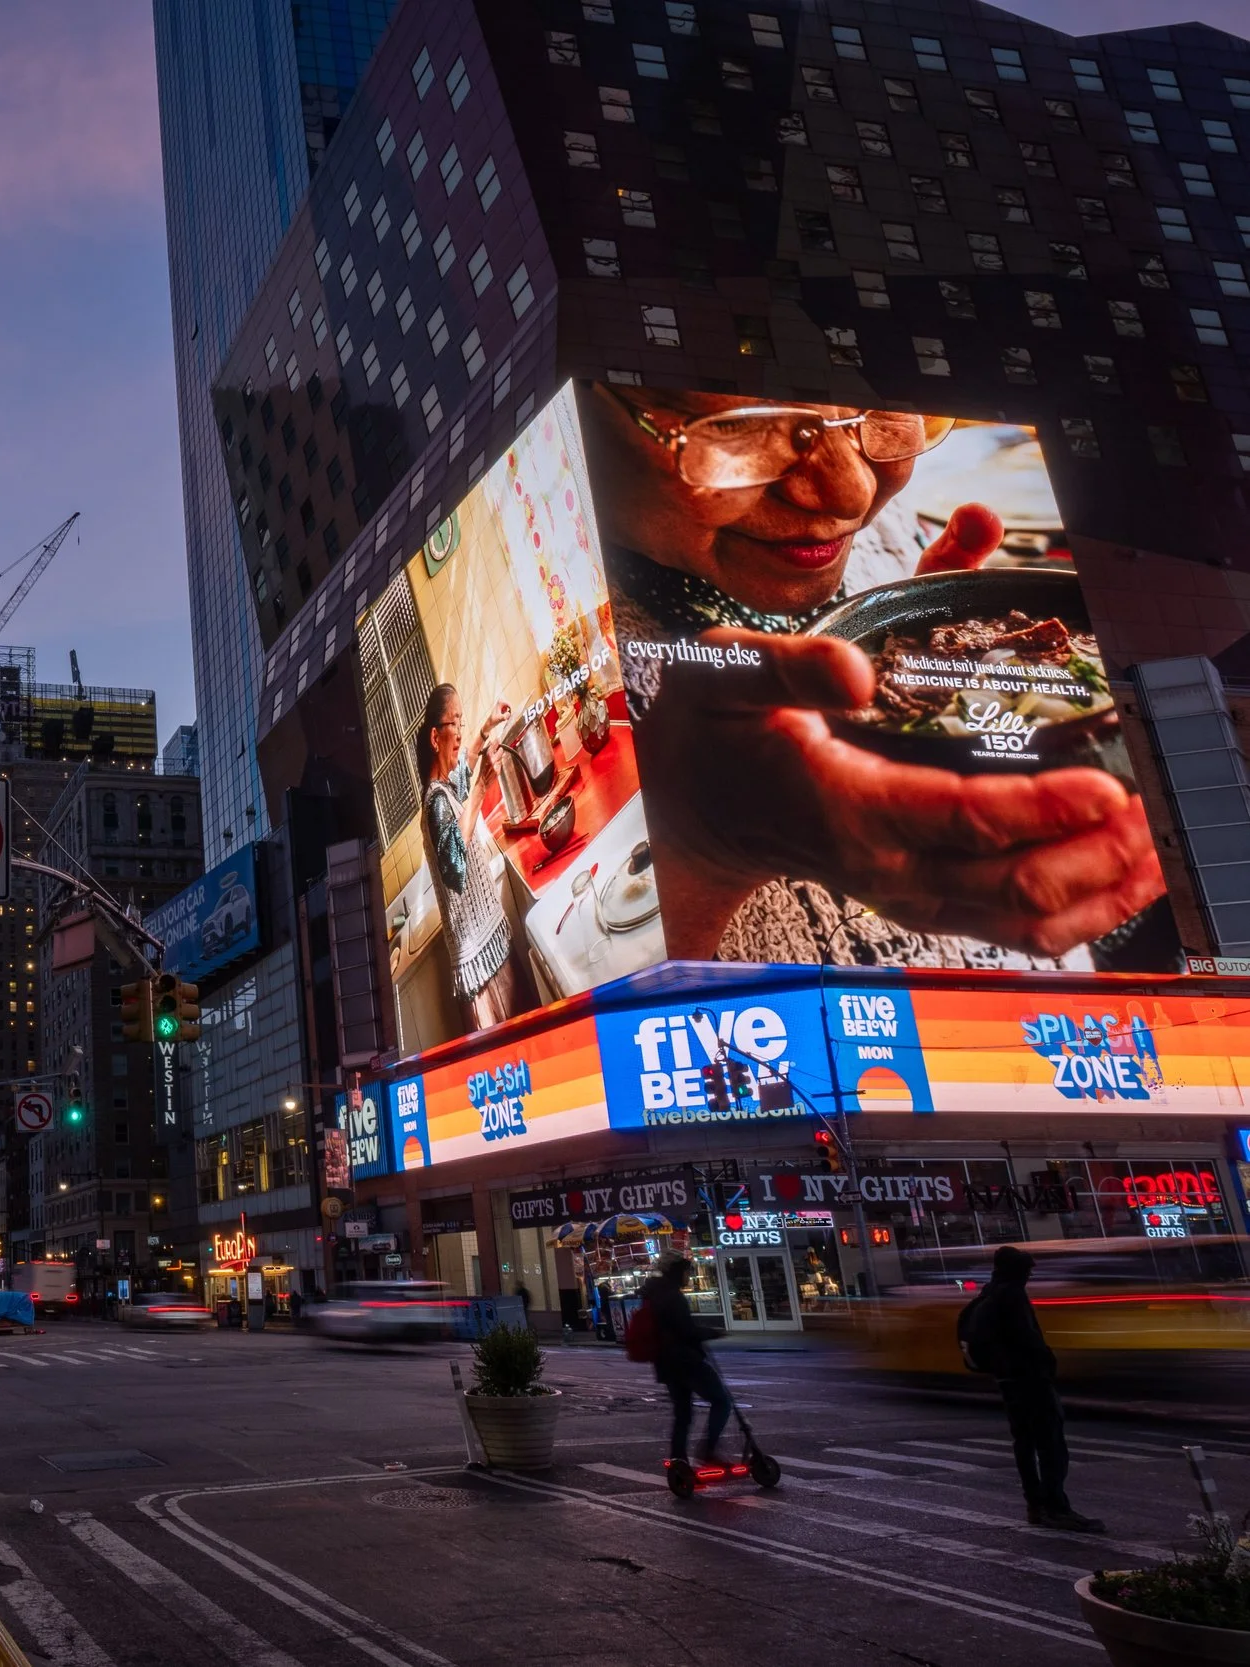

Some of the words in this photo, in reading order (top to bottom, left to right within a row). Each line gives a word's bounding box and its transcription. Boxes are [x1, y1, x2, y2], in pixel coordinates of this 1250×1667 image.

[627, 637, 725, 669] everything
[726, 641, 761, 666] else
[901, 654, 952, 672] Medicine
[952, 658, 976, 673] isn't
[973, 661, 995, 676] just
[996, 661, 1027, 677] about
[1027, 664, 1073, 680] sickness.
[522, 698, 545, 724] 150
[545, 663, 590, 710] YEARS
[591, 647, 610, 672] OF
[893, 673, 964, 689] MEDICINE
[965, 678, 980, 689] IS
[982, 679, 1029, 692] ABOUT
[1031, 683, 1091, 697] HEALTH.
[965, 701, 1037, 745] Lilly
[972, 750, 996, 759] YEARS
[1005, 752, 1040, 761] MEDICINE
[981, 734, 1024, 752] 150
[162, 899, 186, 925] YOUR
[186, 885, 205, 911] CAR
[1188, 958, 1215, 973] BIG
[838, 994, 896, 1021] five
[633, 1006, 788, 1072] five
[842, 1019, 897, 1037] BELOW
[857, 1046, 894, 1060] MON
[158, 1041, 176, 1124] WESTIN
[467, 1059, 527, 1102] SPLASH
[1048, 1054, 1138, 1089] ZONE
[397, 1082, 419, 1105] five
[478, 1097, 522, 1133] ZONE
[511, 1197, 555, 1220] GIFTS
[582, 1187, 613, 1214] NY
[619, 1179, 688, 1211] GIFTS
[759, 1174, 777, 1202] I
[800, 1174, 849, 1202] NY
[859, 1175, 954, 1202] GIFTS
[1146, 1227, 1186, 1238] GIFTS
[1158, 1214, 1182, 1226] NY
[719, 1230, 782, 1245] GIFTS
